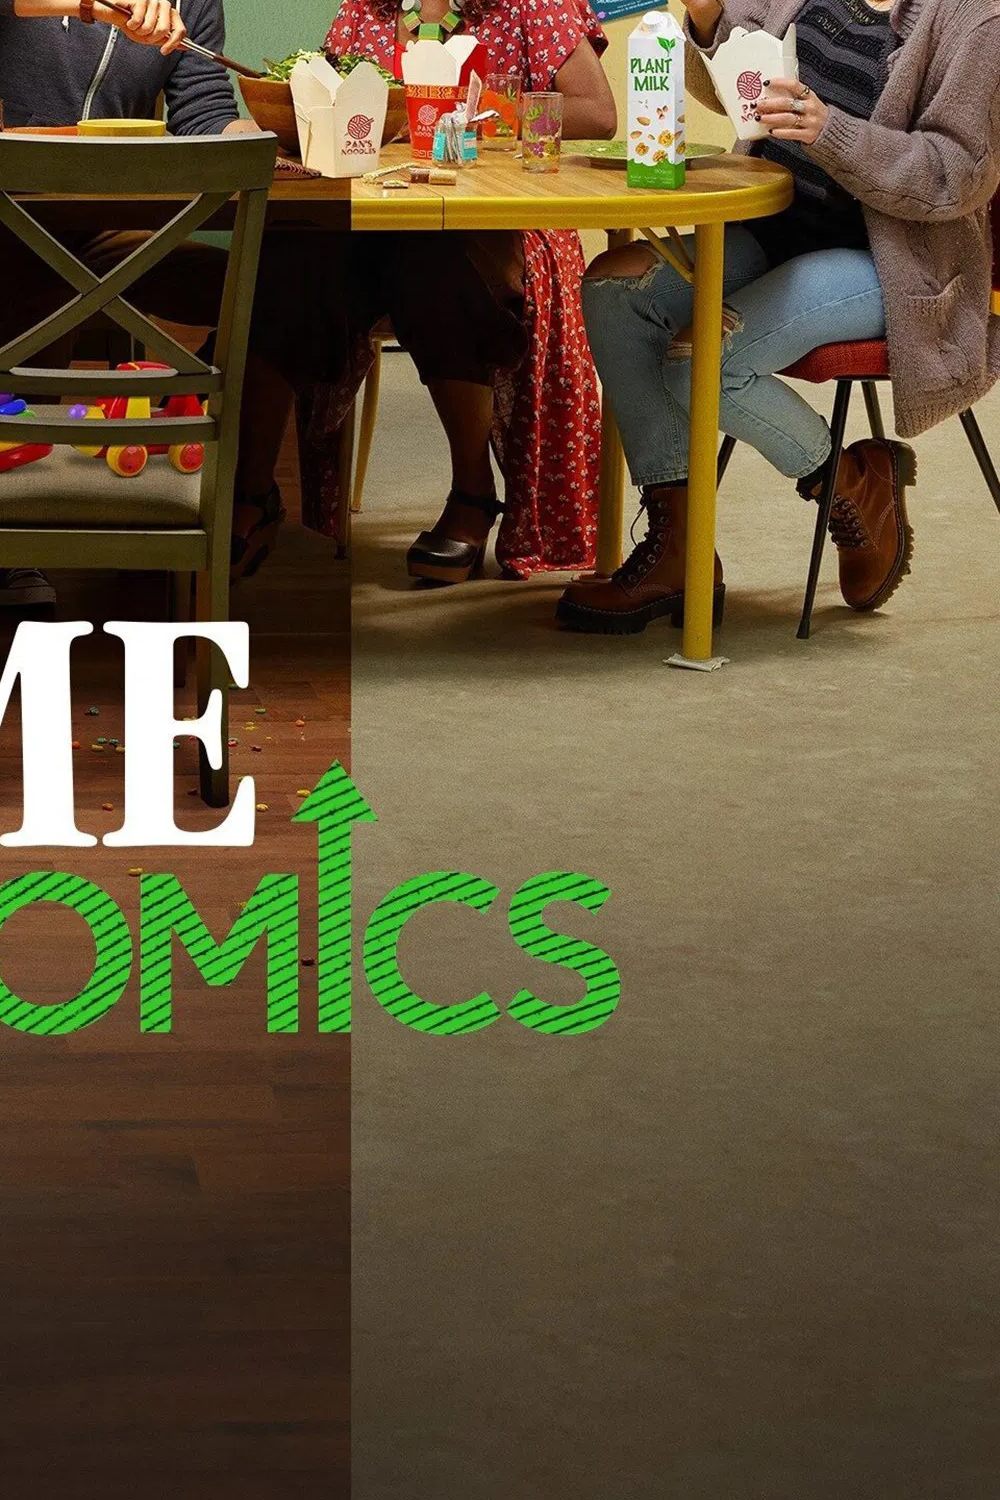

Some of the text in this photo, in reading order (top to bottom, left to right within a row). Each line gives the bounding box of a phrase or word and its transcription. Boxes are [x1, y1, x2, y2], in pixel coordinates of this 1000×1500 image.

[630, 58, 673, 74] PLANT
[634, 76, 670, 92] MILK
[345, 140, 373, 148] PAN'S
[341, 148, 377, 156] NOODLES
